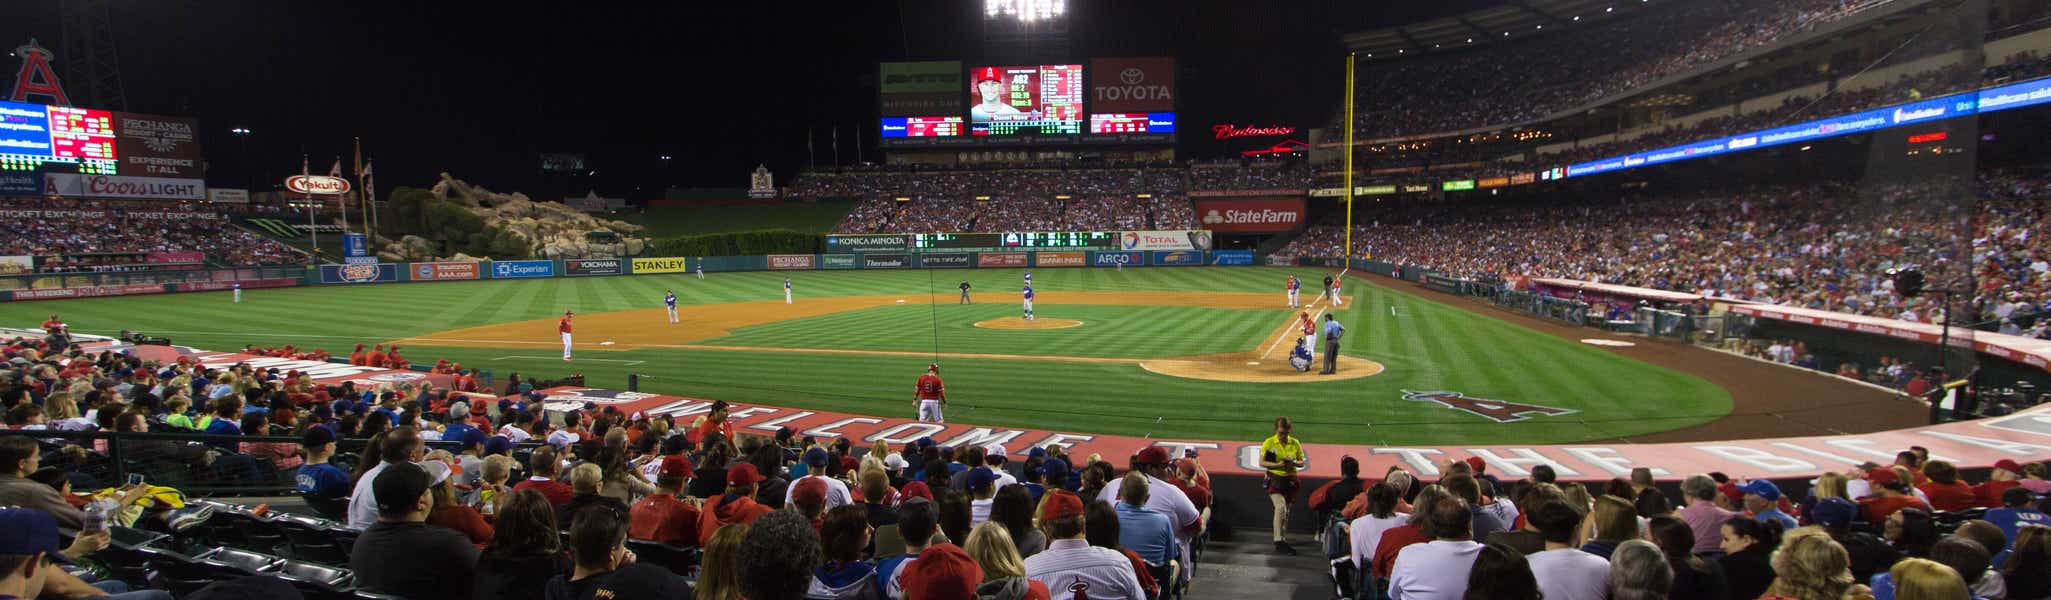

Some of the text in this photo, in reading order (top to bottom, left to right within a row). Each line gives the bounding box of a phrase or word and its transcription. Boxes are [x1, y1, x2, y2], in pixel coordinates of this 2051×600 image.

[1095, 86, 1171, 100] TOYOTA
[123, 119, 192, 133] PECHANGA
[1212, 124, 1296, 140] Budweiser
[129, 157, 193, 168] EXPERIENCE
[147, 165, 179, 174] IT ALL
[88, 176, 147, 195] Coors
[149, 184, 195, 196] LIGHT
[299, 180, 341, 190] Yakult
[45, 210, 104, 219] EXCHNGE
[167, 211, 217, 220] EXCHNGE
[839, 236, 904, 246] KONICA MINOLTA
[1143, 234, 1178, 244] TOTAL
[1097, 253, 1129, 264] ARCO
[513, 265, 549, 274] Experian
[581, 261, 617, 269] YOKOHAMA
[634, 260, 683, 270] STANLEY
[36, 289, 74, 297] WEEKEND
[645, 400, 1096, 456] WELCOME
[1370, 448, 1672, 477] THE
